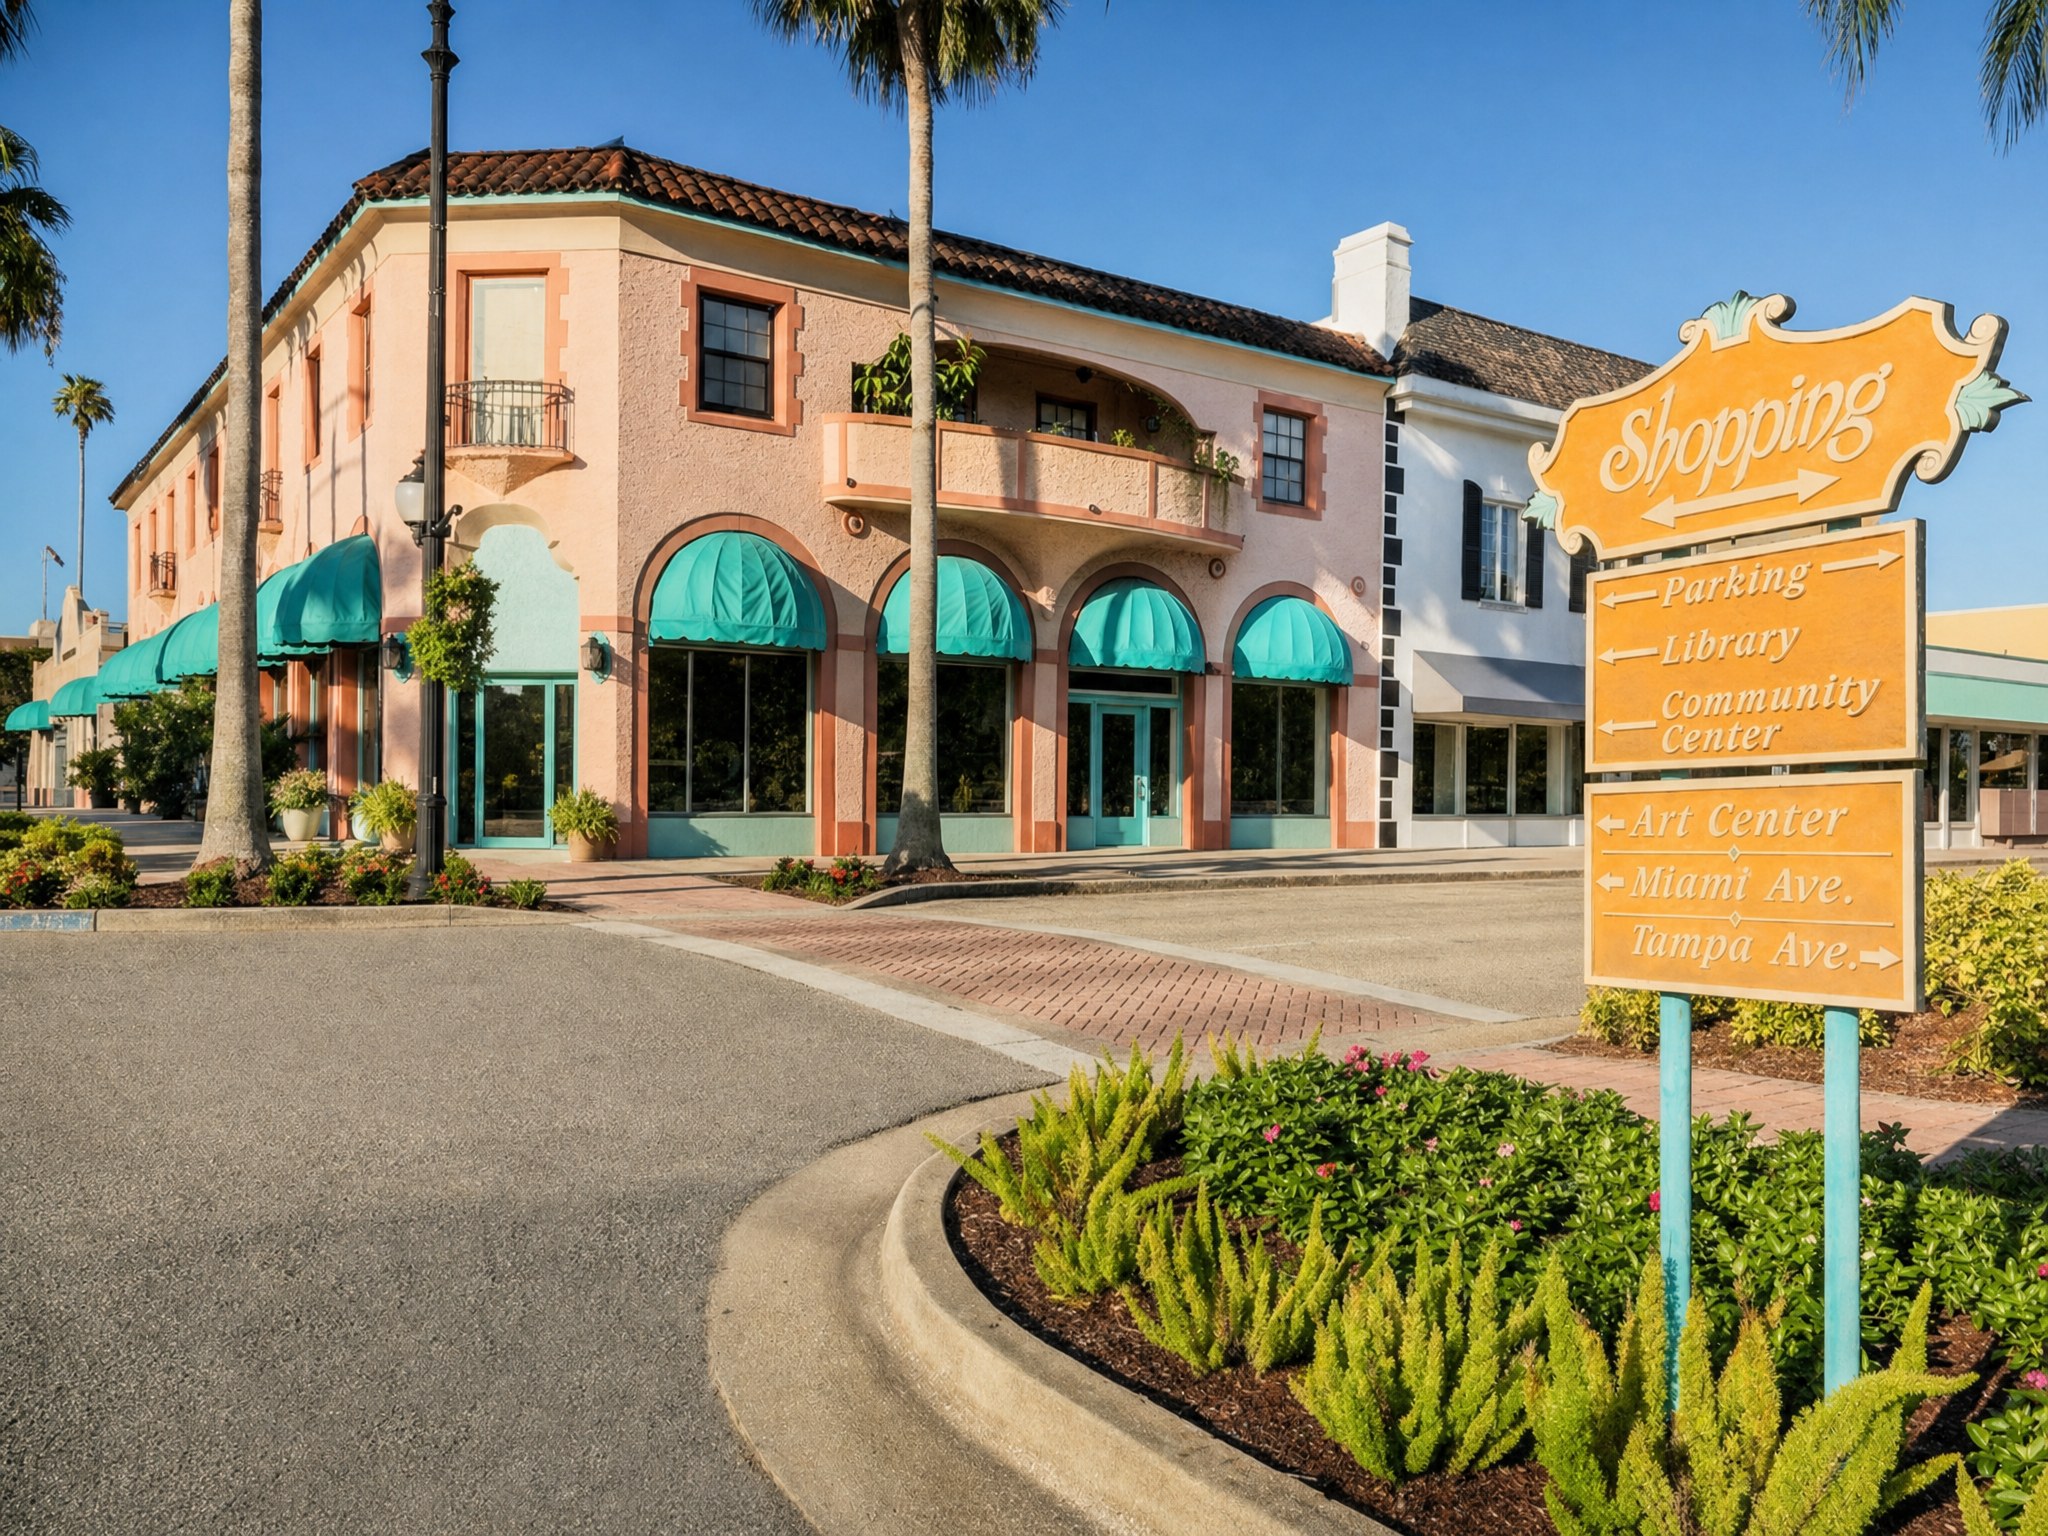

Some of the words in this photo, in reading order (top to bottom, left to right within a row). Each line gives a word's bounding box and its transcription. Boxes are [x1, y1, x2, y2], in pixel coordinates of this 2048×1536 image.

[1600, 362, 1893, 496] Shopping
[1660, 560, 1811, 609] Parking
[1660, 626, 1800, 666] Library
[1661, 674, 1881, 720] Community
[1661, 721, 1782, 754] Center
[1628, 804, 1694, 838] Art
[1708, 802, 1848, 838] Center
[1629, 866, 1750, 901] Miami
[1763, 867, 1853, 905] Ave.
[1631, 924, 1752, 969] Tampa
[1768, 931, 1857, 970] Ave.
